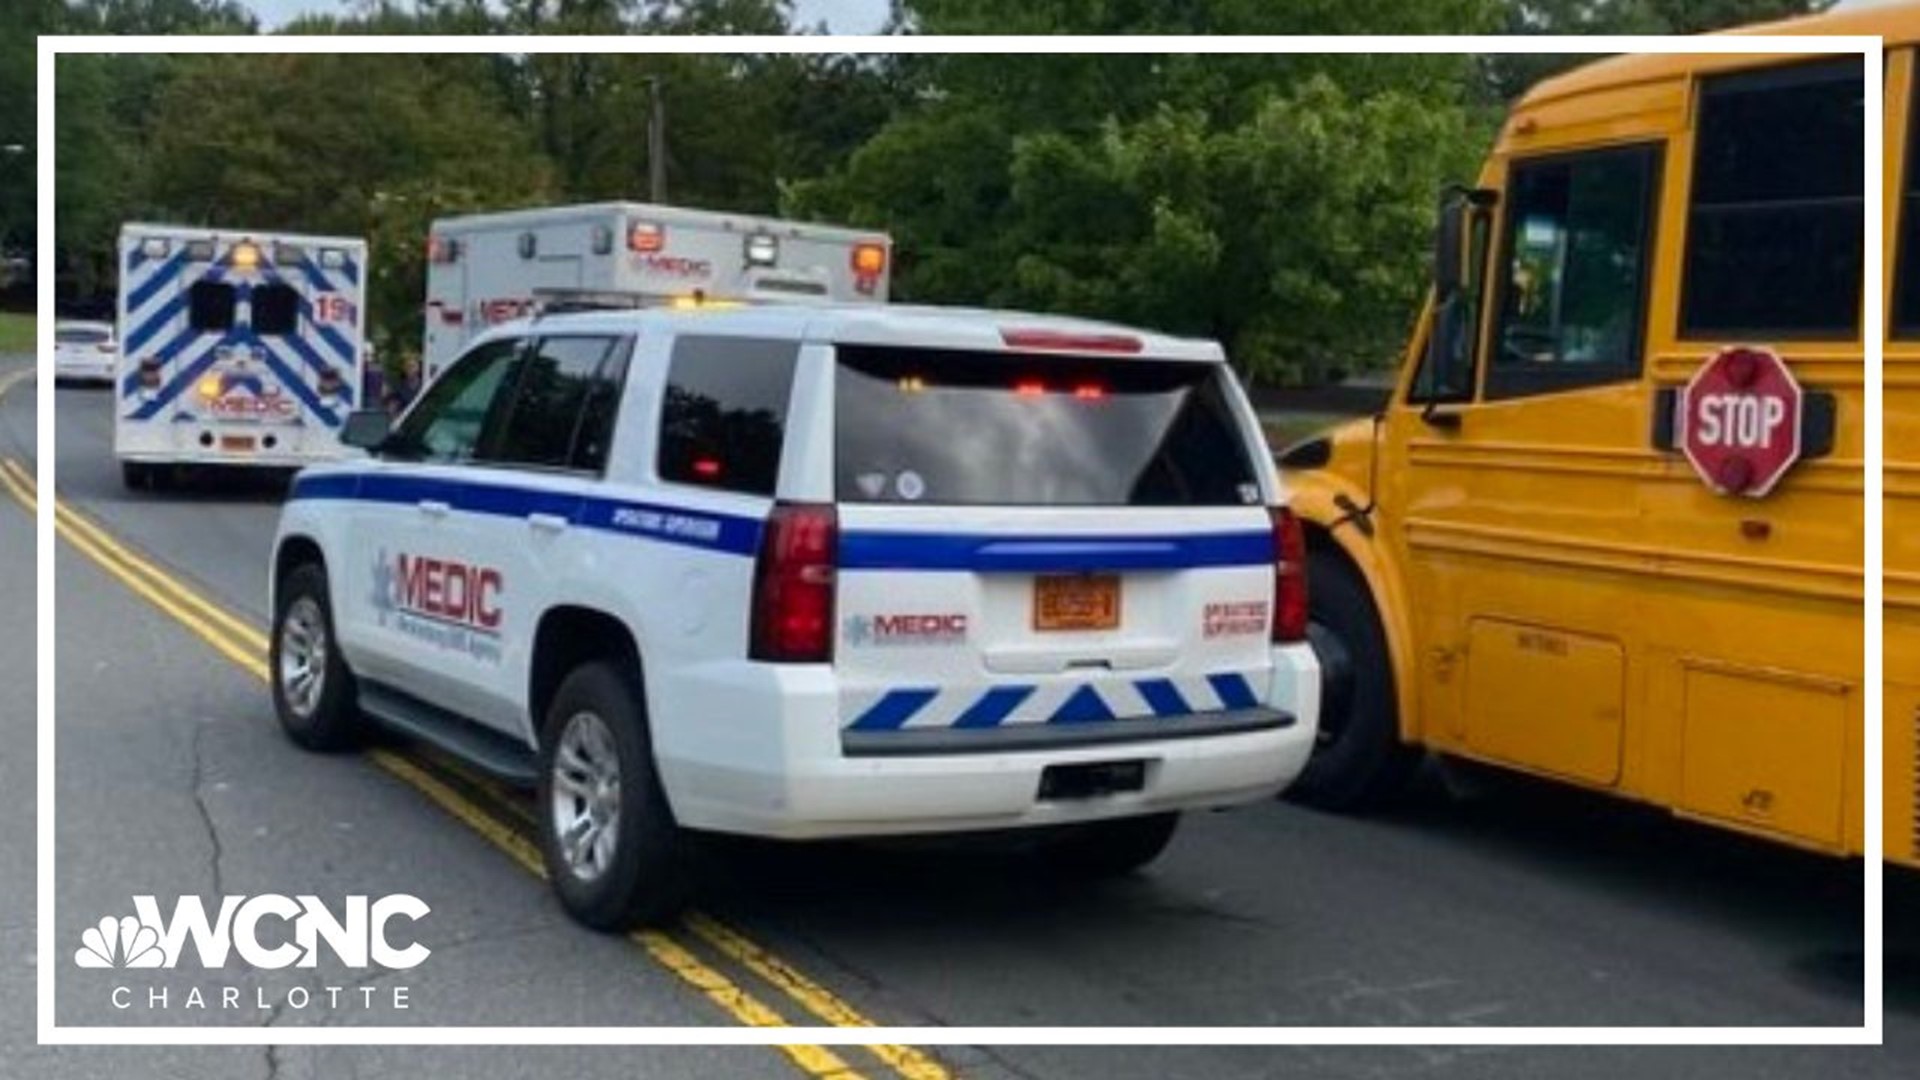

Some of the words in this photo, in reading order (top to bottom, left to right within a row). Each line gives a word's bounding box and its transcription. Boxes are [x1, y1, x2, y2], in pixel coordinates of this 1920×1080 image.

[1699, 395, 1784, 448] STOP
[396, 552, 503, 628] MEDIC
[873, 615, 967, 635] MEDIC
